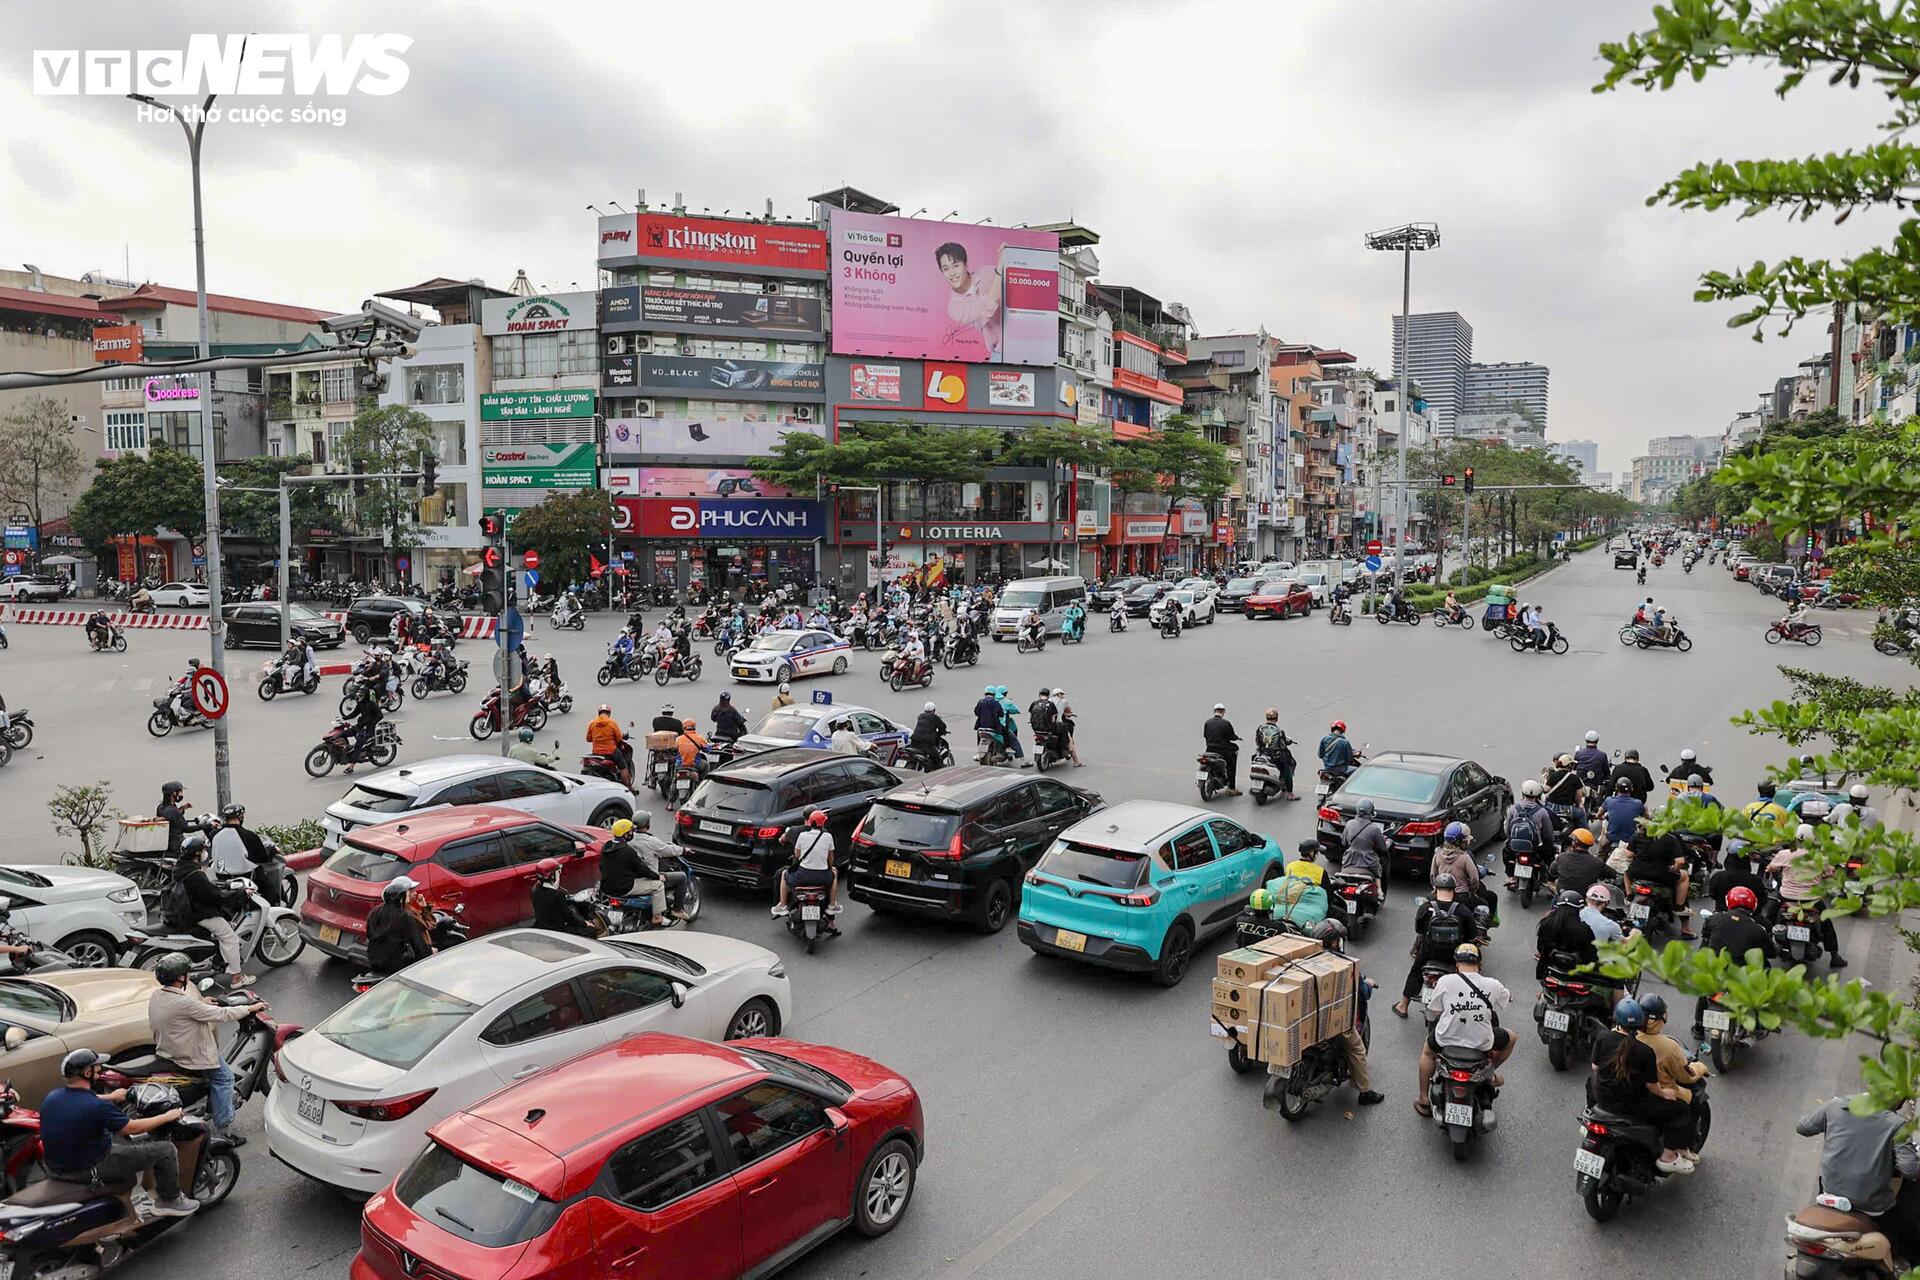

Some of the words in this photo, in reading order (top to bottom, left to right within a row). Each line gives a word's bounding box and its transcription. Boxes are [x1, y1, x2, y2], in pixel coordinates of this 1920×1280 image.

[667, 224, 756, 251] Kingston
[684, 244, 757, 255] TECHNOLOGY
[888, 254, 903, 268] lợi
[844, 267, 851, 278] 3
[855, 267, 896, 284] Không
[538, 319, 568, 330] SPACY
[614, 375, 632, 384] Digital
[145, 380, 199, 401] Goodress
[496, 452, 525, 462] Castrol
[486, 474, 508, 485] HOÀN
[509, 475, 532, 484] SPACY
[920, 527, 1002, 539] LOTTERIA
[1450, 1002, 1483, 1014] Atelier
[1473, 1014, 1484, 1022] 25
